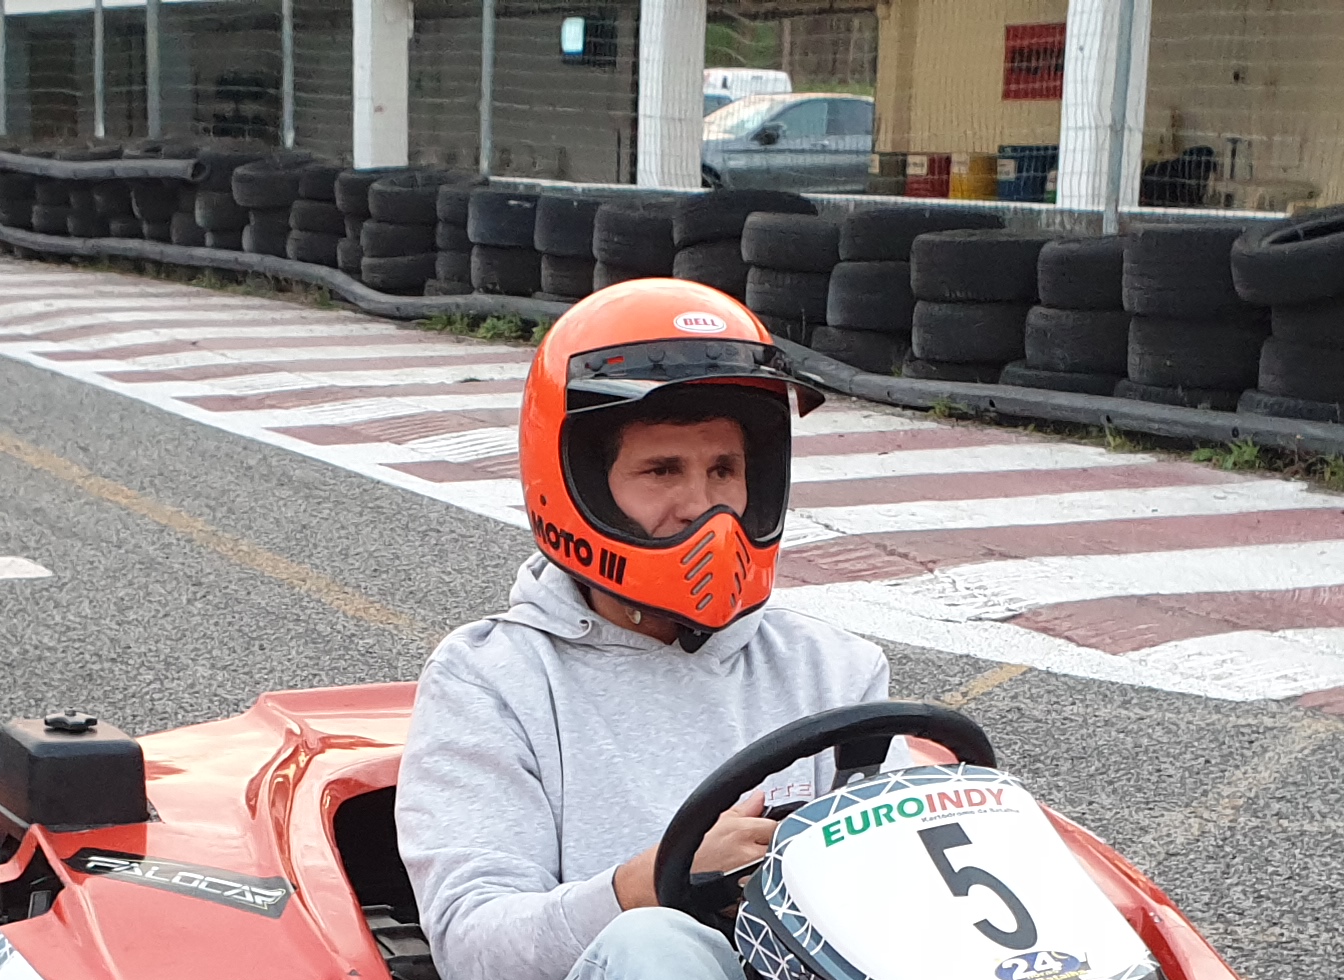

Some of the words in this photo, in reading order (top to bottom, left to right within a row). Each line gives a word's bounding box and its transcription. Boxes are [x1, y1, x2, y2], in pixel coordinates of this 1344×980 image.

[683, 317, 719, 327] BELL
[531, 510, 594, 568] MOTO
[599, 547, 627, 586] III
[822, 788, 1004, 848] EUROINDY
[86, 856, 286, 905] PALOCAR
[917, 822, 1037, 950] 5
[1001, 951, 1063, 980] 24
